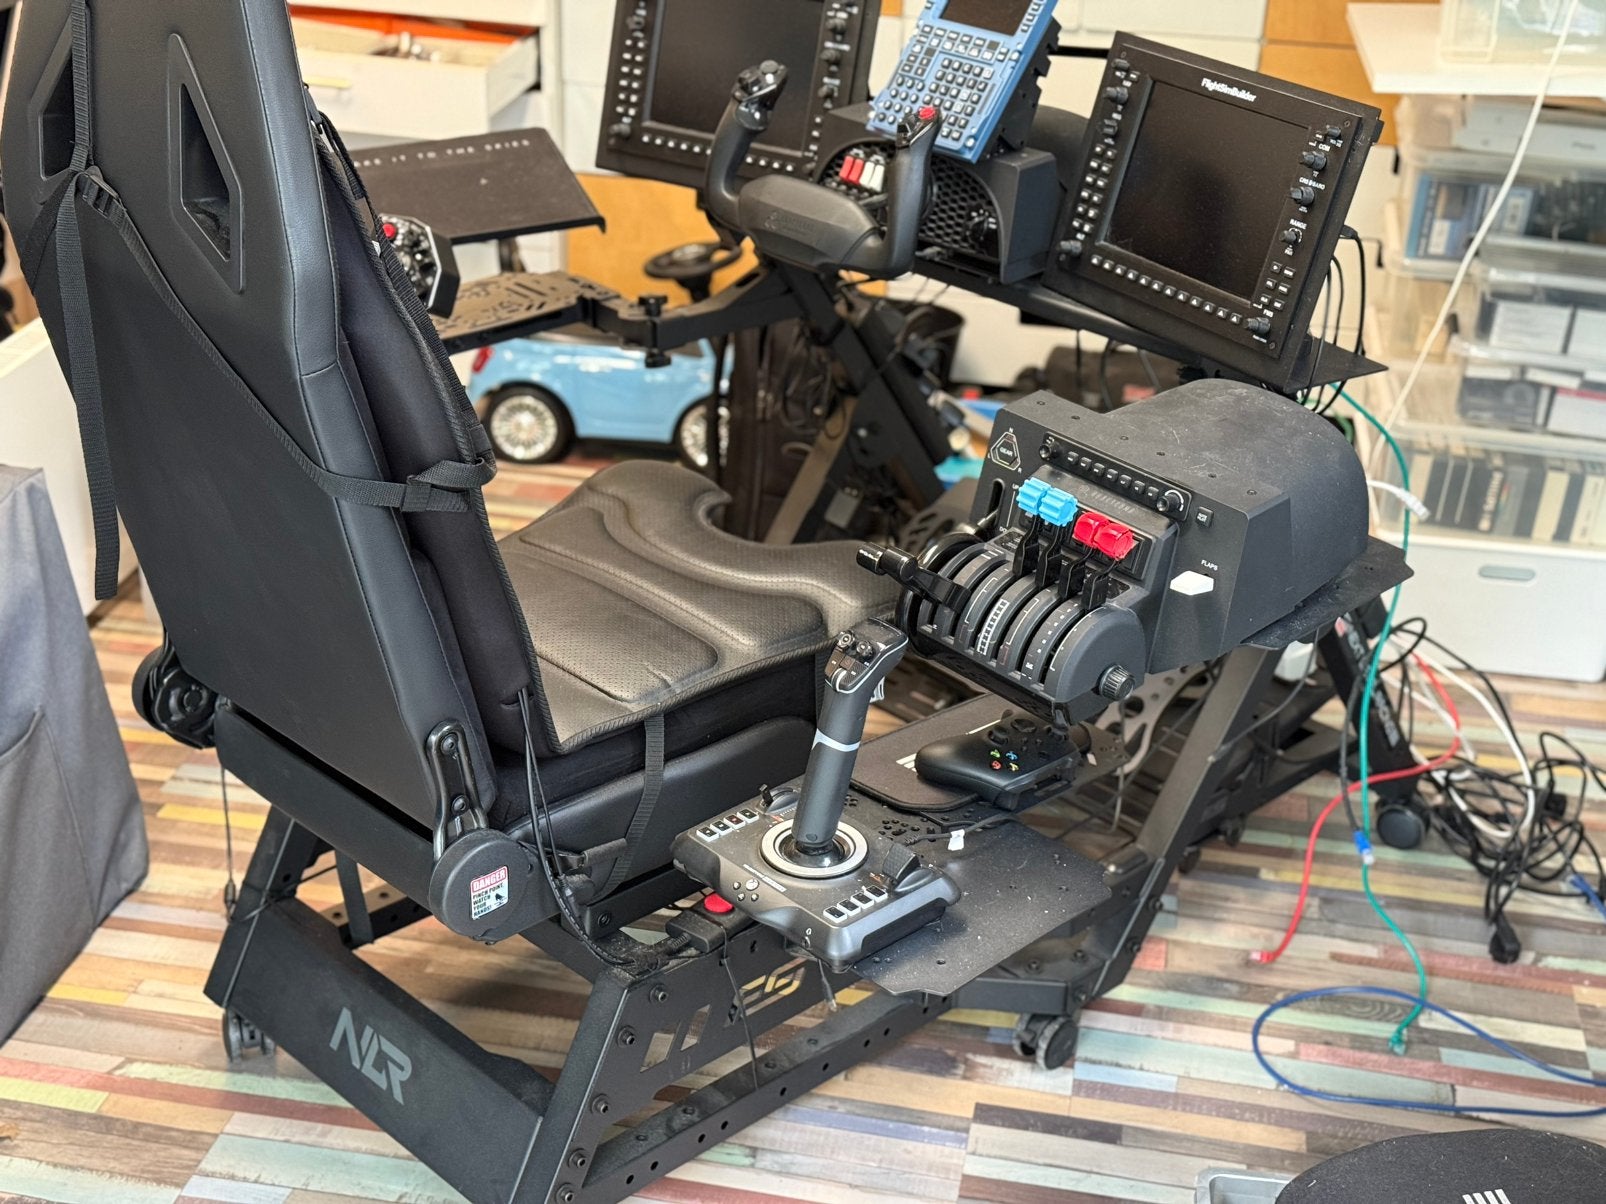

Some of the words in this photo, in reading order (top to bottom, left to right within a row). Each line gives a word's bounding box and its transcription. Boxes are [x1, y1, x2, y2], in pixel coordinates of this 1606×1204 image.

[1200, 77, 1257, 102] FlightSimBuilder
[353, 158, 381, 168] AKE
[999, 446, 1014, 457] GEAR
[1201, 559, 1218, 571] FLAPS
[473, 869, 506, 892] DANGER
[473, 890, 489, 900] PINCH
[489, 882, 503, 894] POINT
[473, 894, 491, 906] WATCH
[473, 901, 487, 911] YOUR
[329, 1006, 412, 1106] NLR
